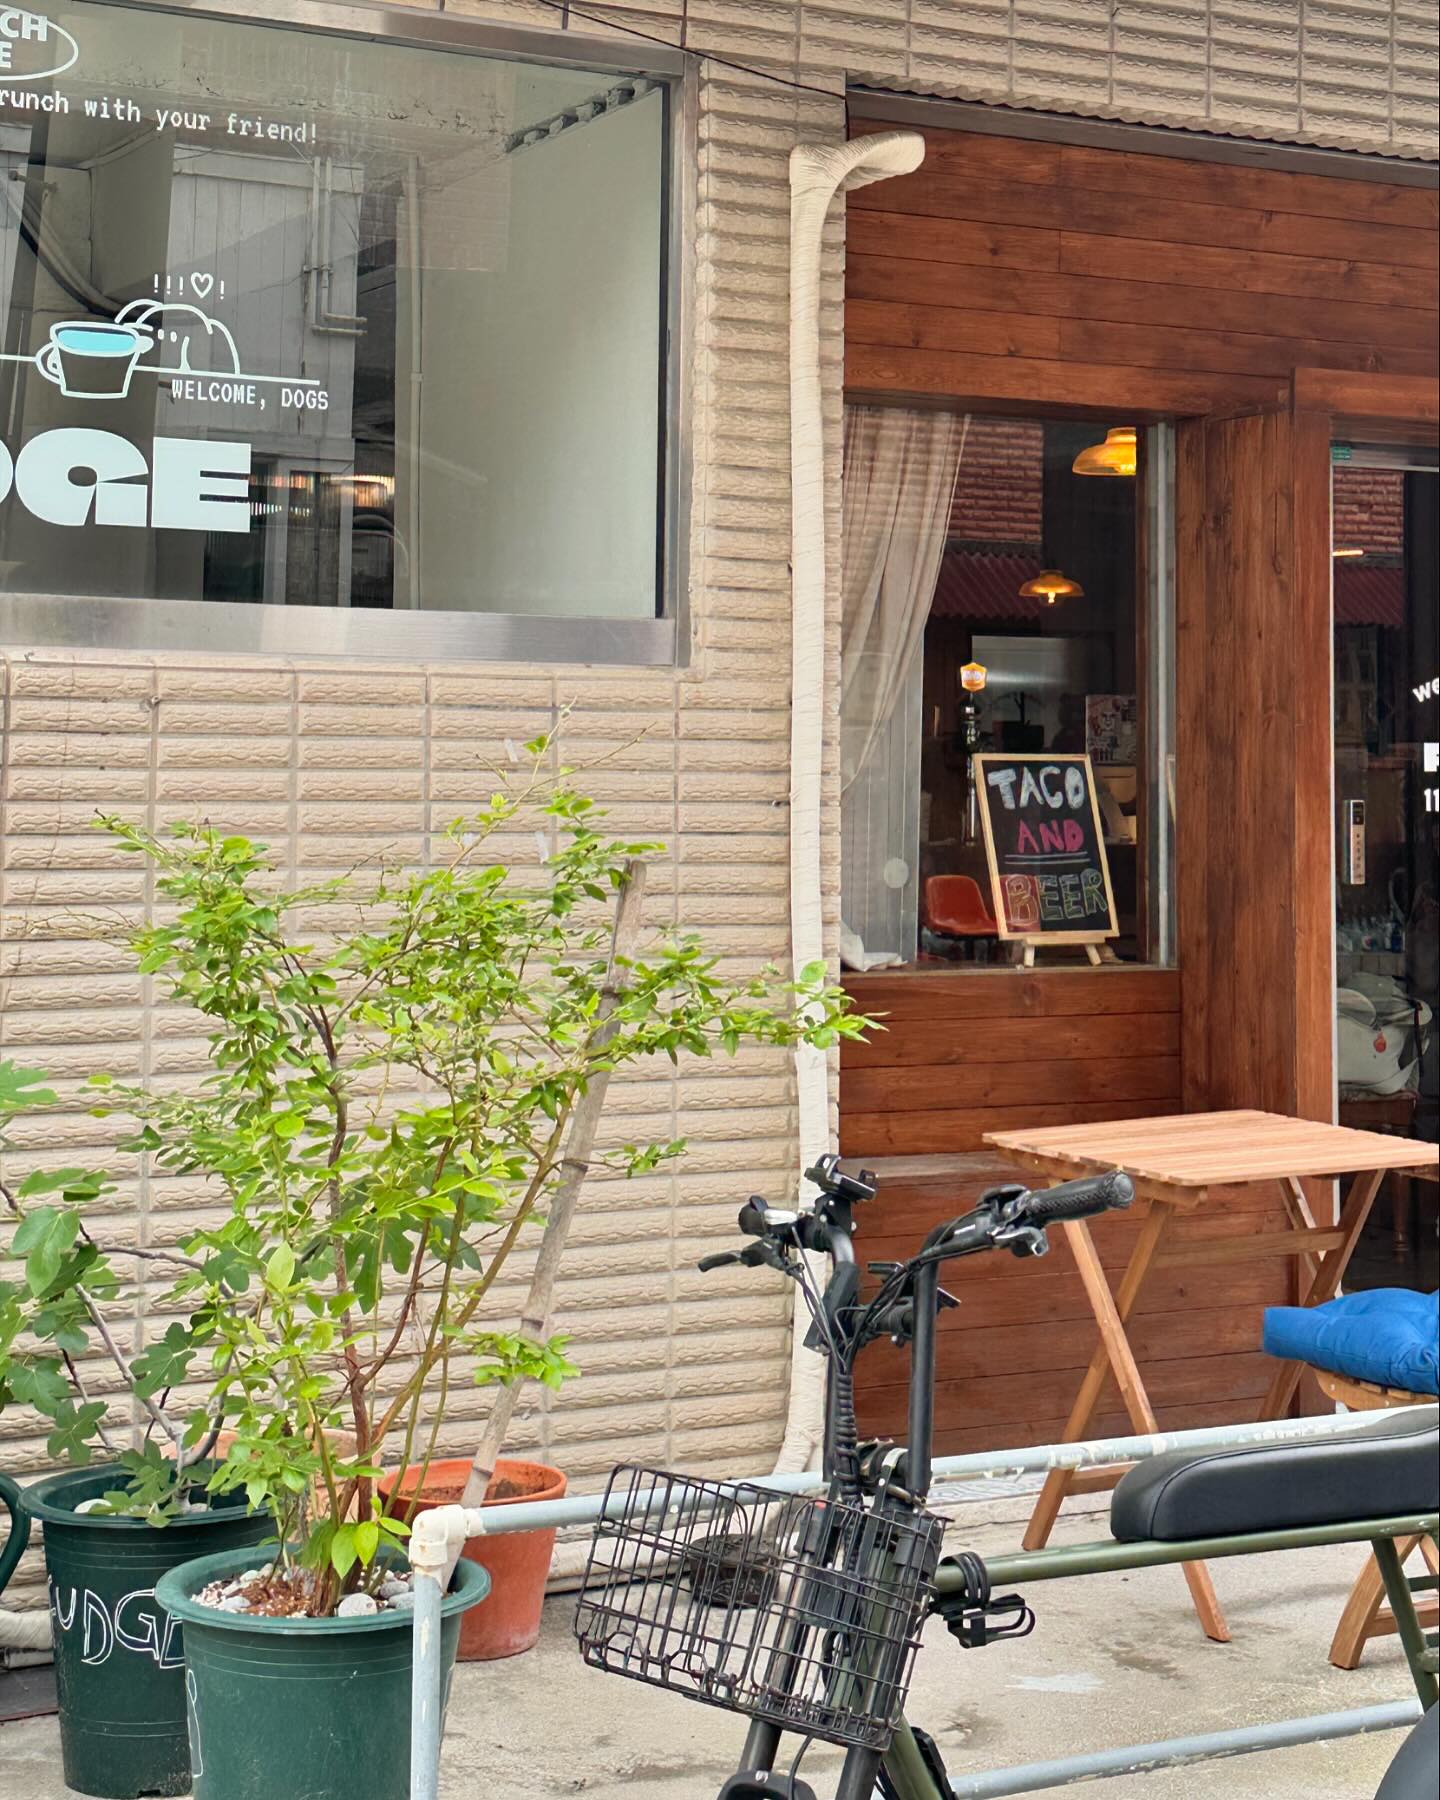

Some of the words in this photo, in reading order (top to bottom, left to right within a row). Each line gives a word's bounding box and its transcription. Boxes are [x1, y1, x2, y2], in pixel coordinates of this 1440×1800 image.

[84, 97, 141, 123] with
[155, 108, 211, 131] your
[226, 112, 317, 144] friend!
[171, 379, 266, 410] WELCOME,
[281, 387, 329, 410] DOGS
[0, 427, 251, 533] GE
[987, 765, 1085, 810] TACO
[1017, 818, 1085, 853] AND
[1004, 868, 1108, 926] BEER
